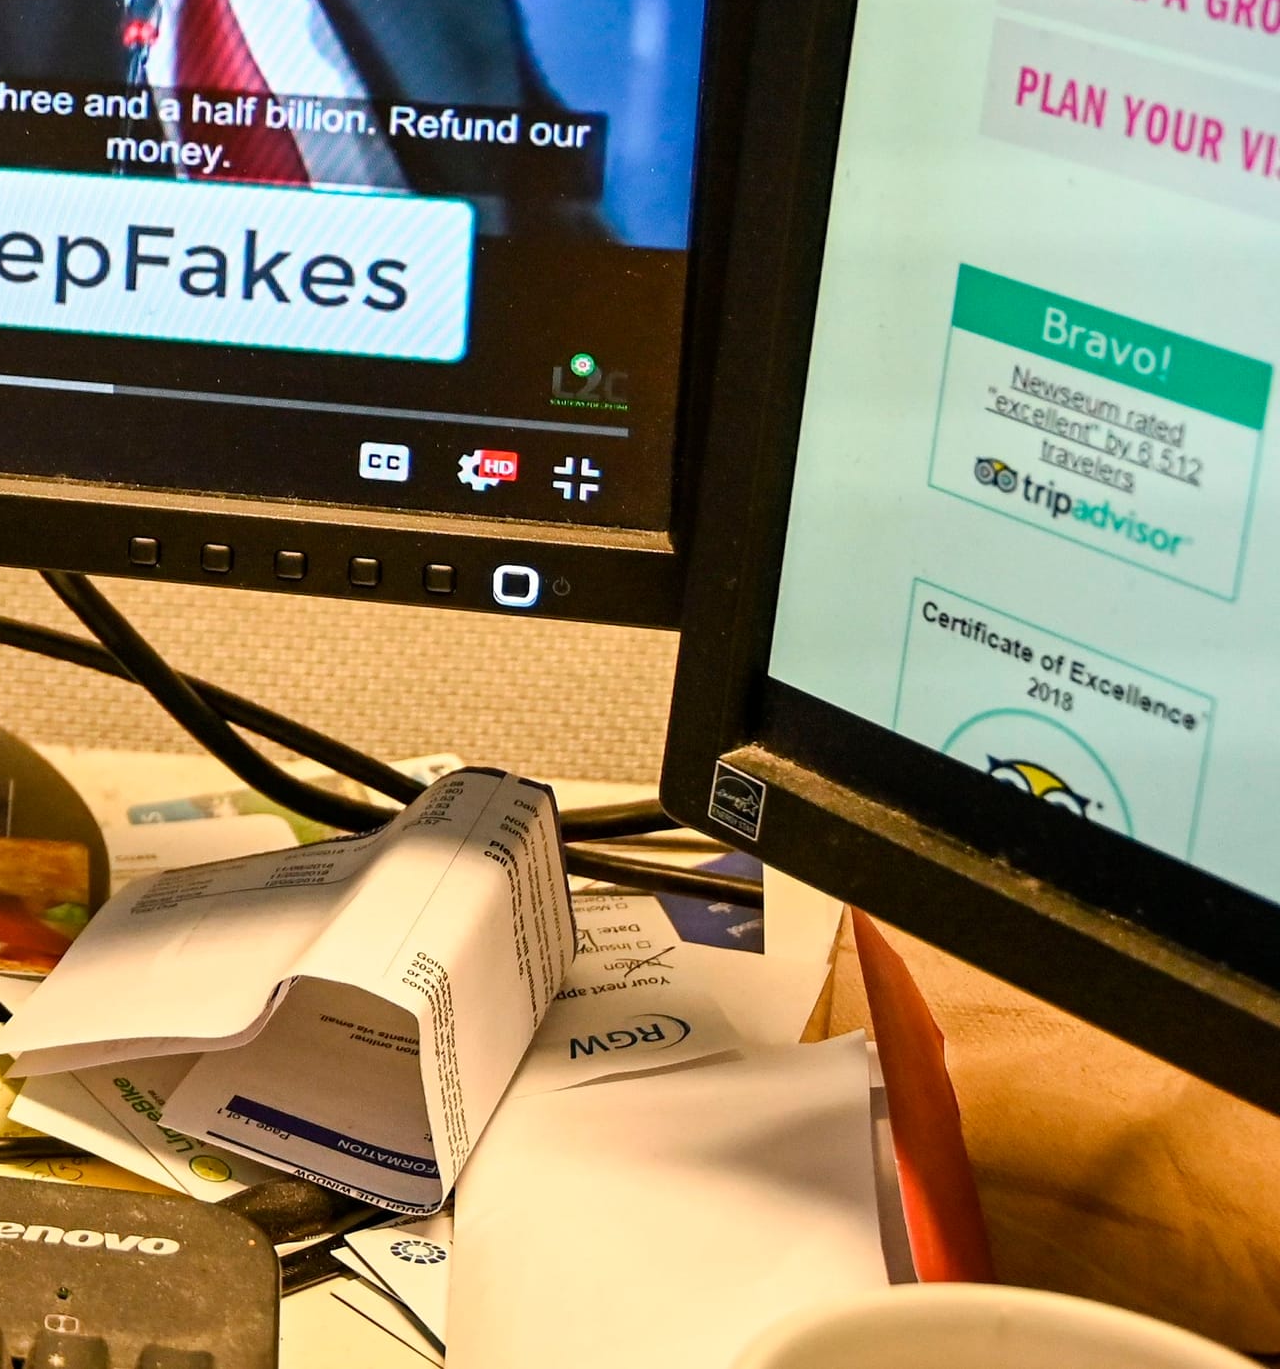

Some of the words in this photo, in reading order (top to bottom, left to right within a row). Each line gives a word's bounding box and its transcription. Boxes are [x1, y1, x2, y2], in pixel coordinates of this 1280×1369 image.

[84, 94, 148, 121] and
[159, 101, 180, 122] a
[191, 94, 259, 127] half
[266, 102, 376, 136] billion.
[389, 106, 519, 144] Refund
[529, 121, 591, 149] our
[1015, 65, 1107, 130] PLAN
[1123, 93, 1225, 164] YOUR
[106, 135, 231, 169] money.
[1041, 306, 1172, 382] Bravo!
[1013, 365, 1121, 422] Newseum
[1125, 409, 1186, 445] rated
[367, 450, 402, 473] CC
[1106, 430, 1130, 458] by
[484, 458, 515, 477] HD
[1040, 438, 1135, 490] travelers
[1021, 474, 1184, 555] tripadvisor
[921, 600, 1034, 664] Certificate
[1041, 652, 1067, 676] of
[1069, 659, 1197, 732] Excellence
[1027, 677, 1074, 713] 2018
[593, 982, 627, 995] next
[632, 976, 671, 989] Your
[570, 1023, 665, 1059] RGW
[293, 1168, 351, 1195] WINDOW
